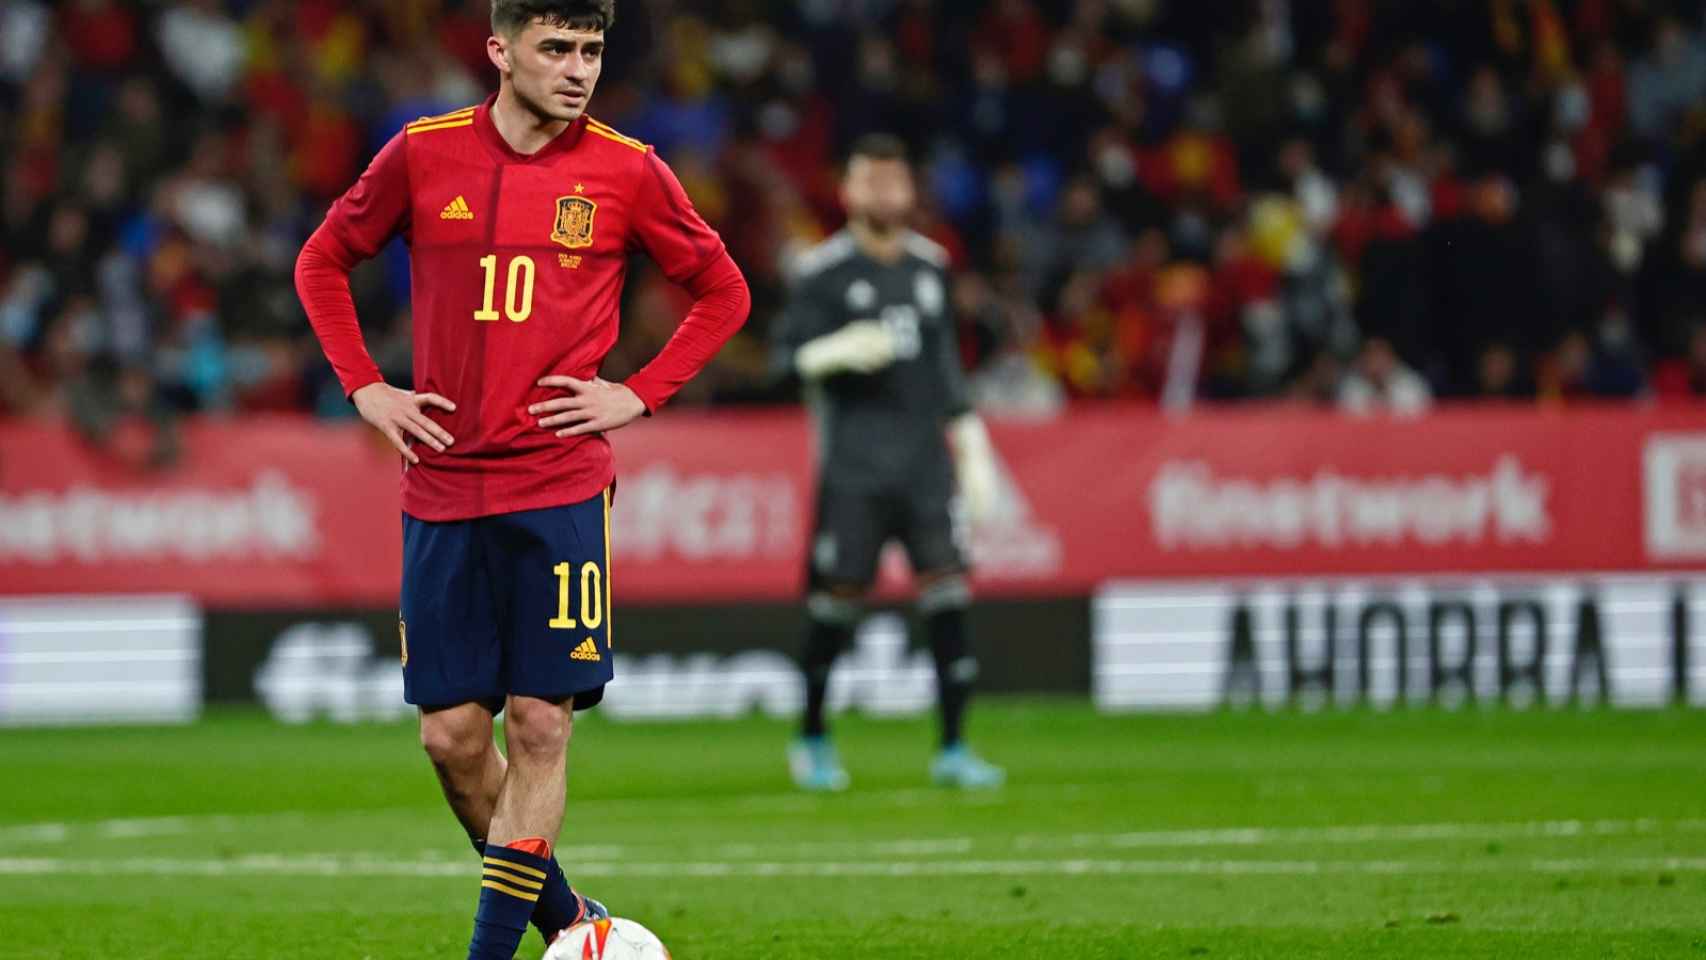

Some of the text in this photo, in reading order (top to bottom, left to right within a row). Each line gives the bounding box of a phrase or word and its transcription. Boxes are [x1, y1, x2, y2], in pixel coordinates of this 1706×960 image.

[440, 210, 474, 220] adidas
[473, 253, 535, 323] 10
[1150, 456, 1550, 551] finetwork
[549, 561, 602, 629] 10
[569, 650, 601, 662] adidas
[1222, 582, 1608, 708] AHORRA
